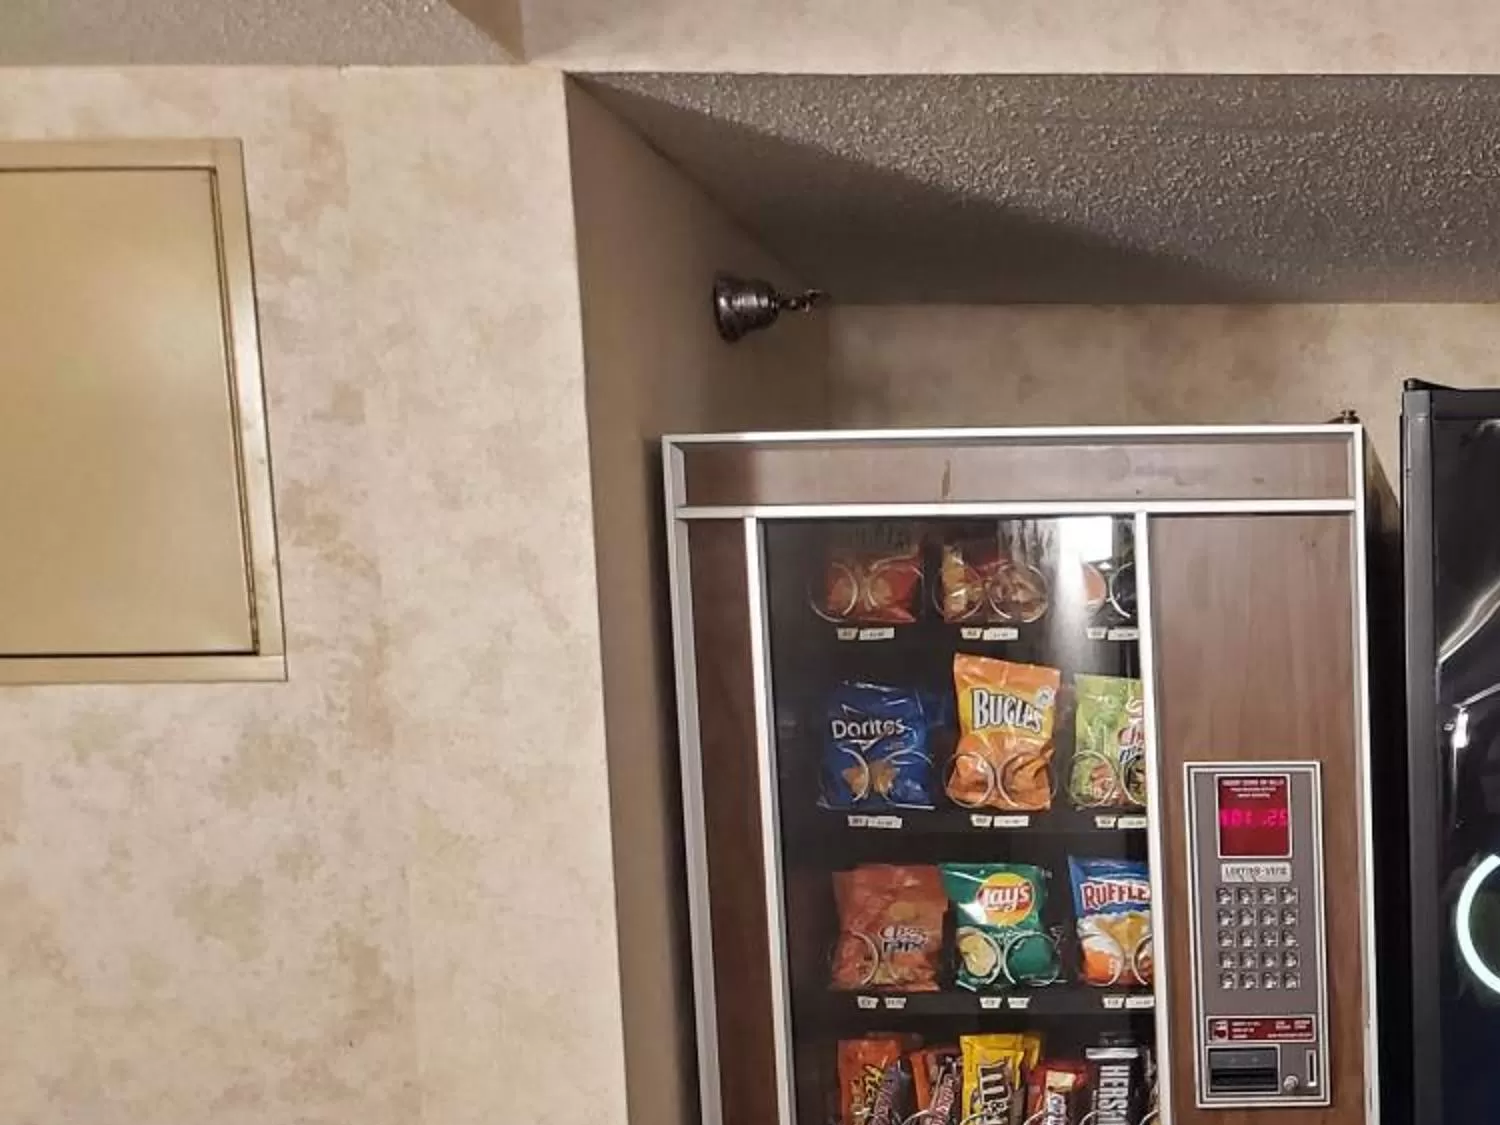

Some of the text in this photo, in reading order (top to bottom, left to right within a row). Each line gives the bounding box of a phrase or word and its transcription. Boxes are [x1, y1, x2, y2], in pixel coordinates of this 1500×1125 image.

[972, 688, 1042, 734] BUGLES
[831, 717, 908, 739] Doritos
[1081, 882, 1150, 911] RUFFLE
